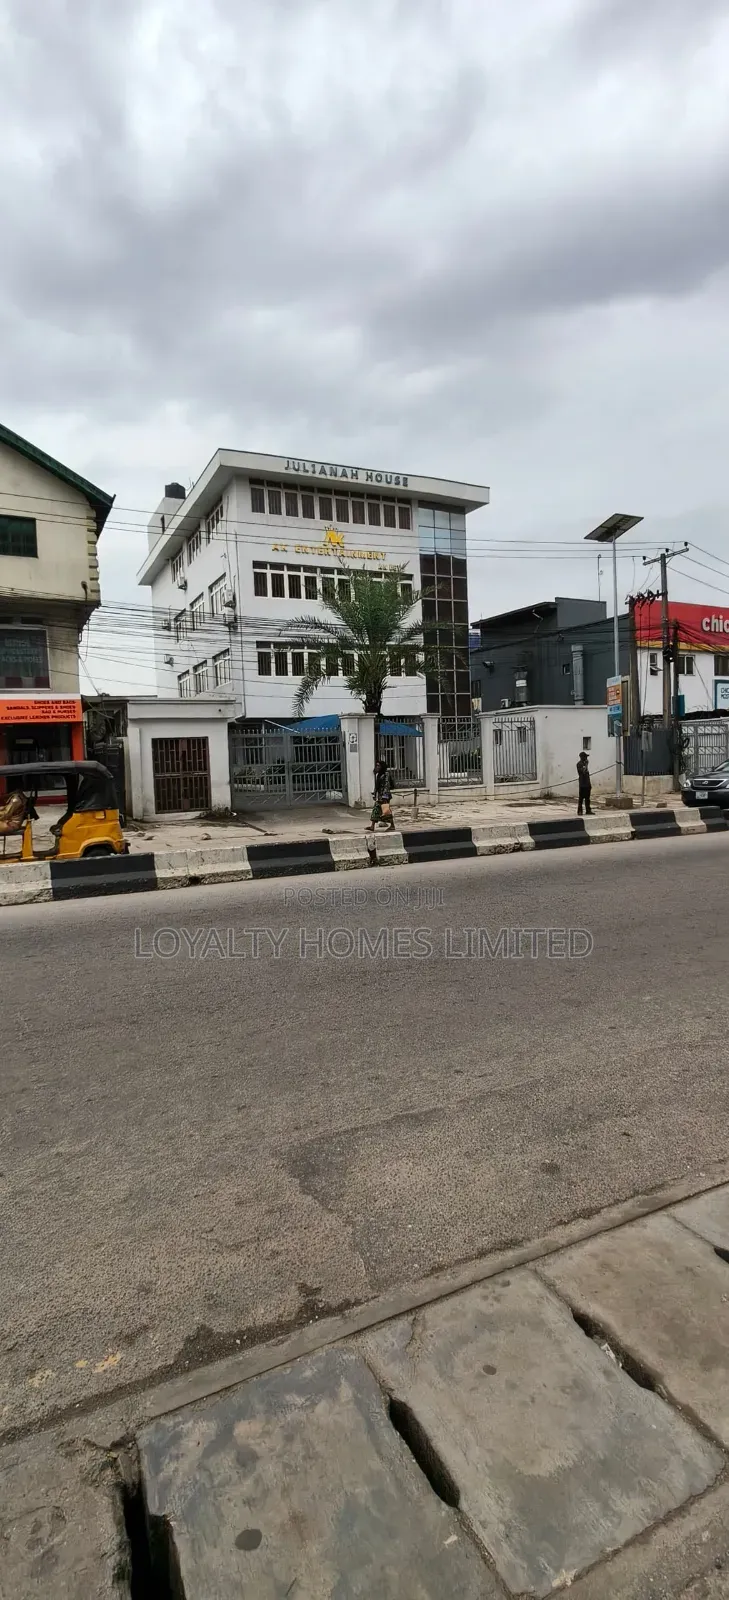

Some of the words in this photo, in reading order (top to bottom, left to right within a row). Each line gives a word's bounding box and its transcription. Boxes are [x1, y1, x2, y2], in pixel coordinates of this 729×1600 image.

[365, 471, 409, 487] HOUSE
[272, 544, 287, 552] AK
[295, 545, 386, 560] ENTERTAINMENT
